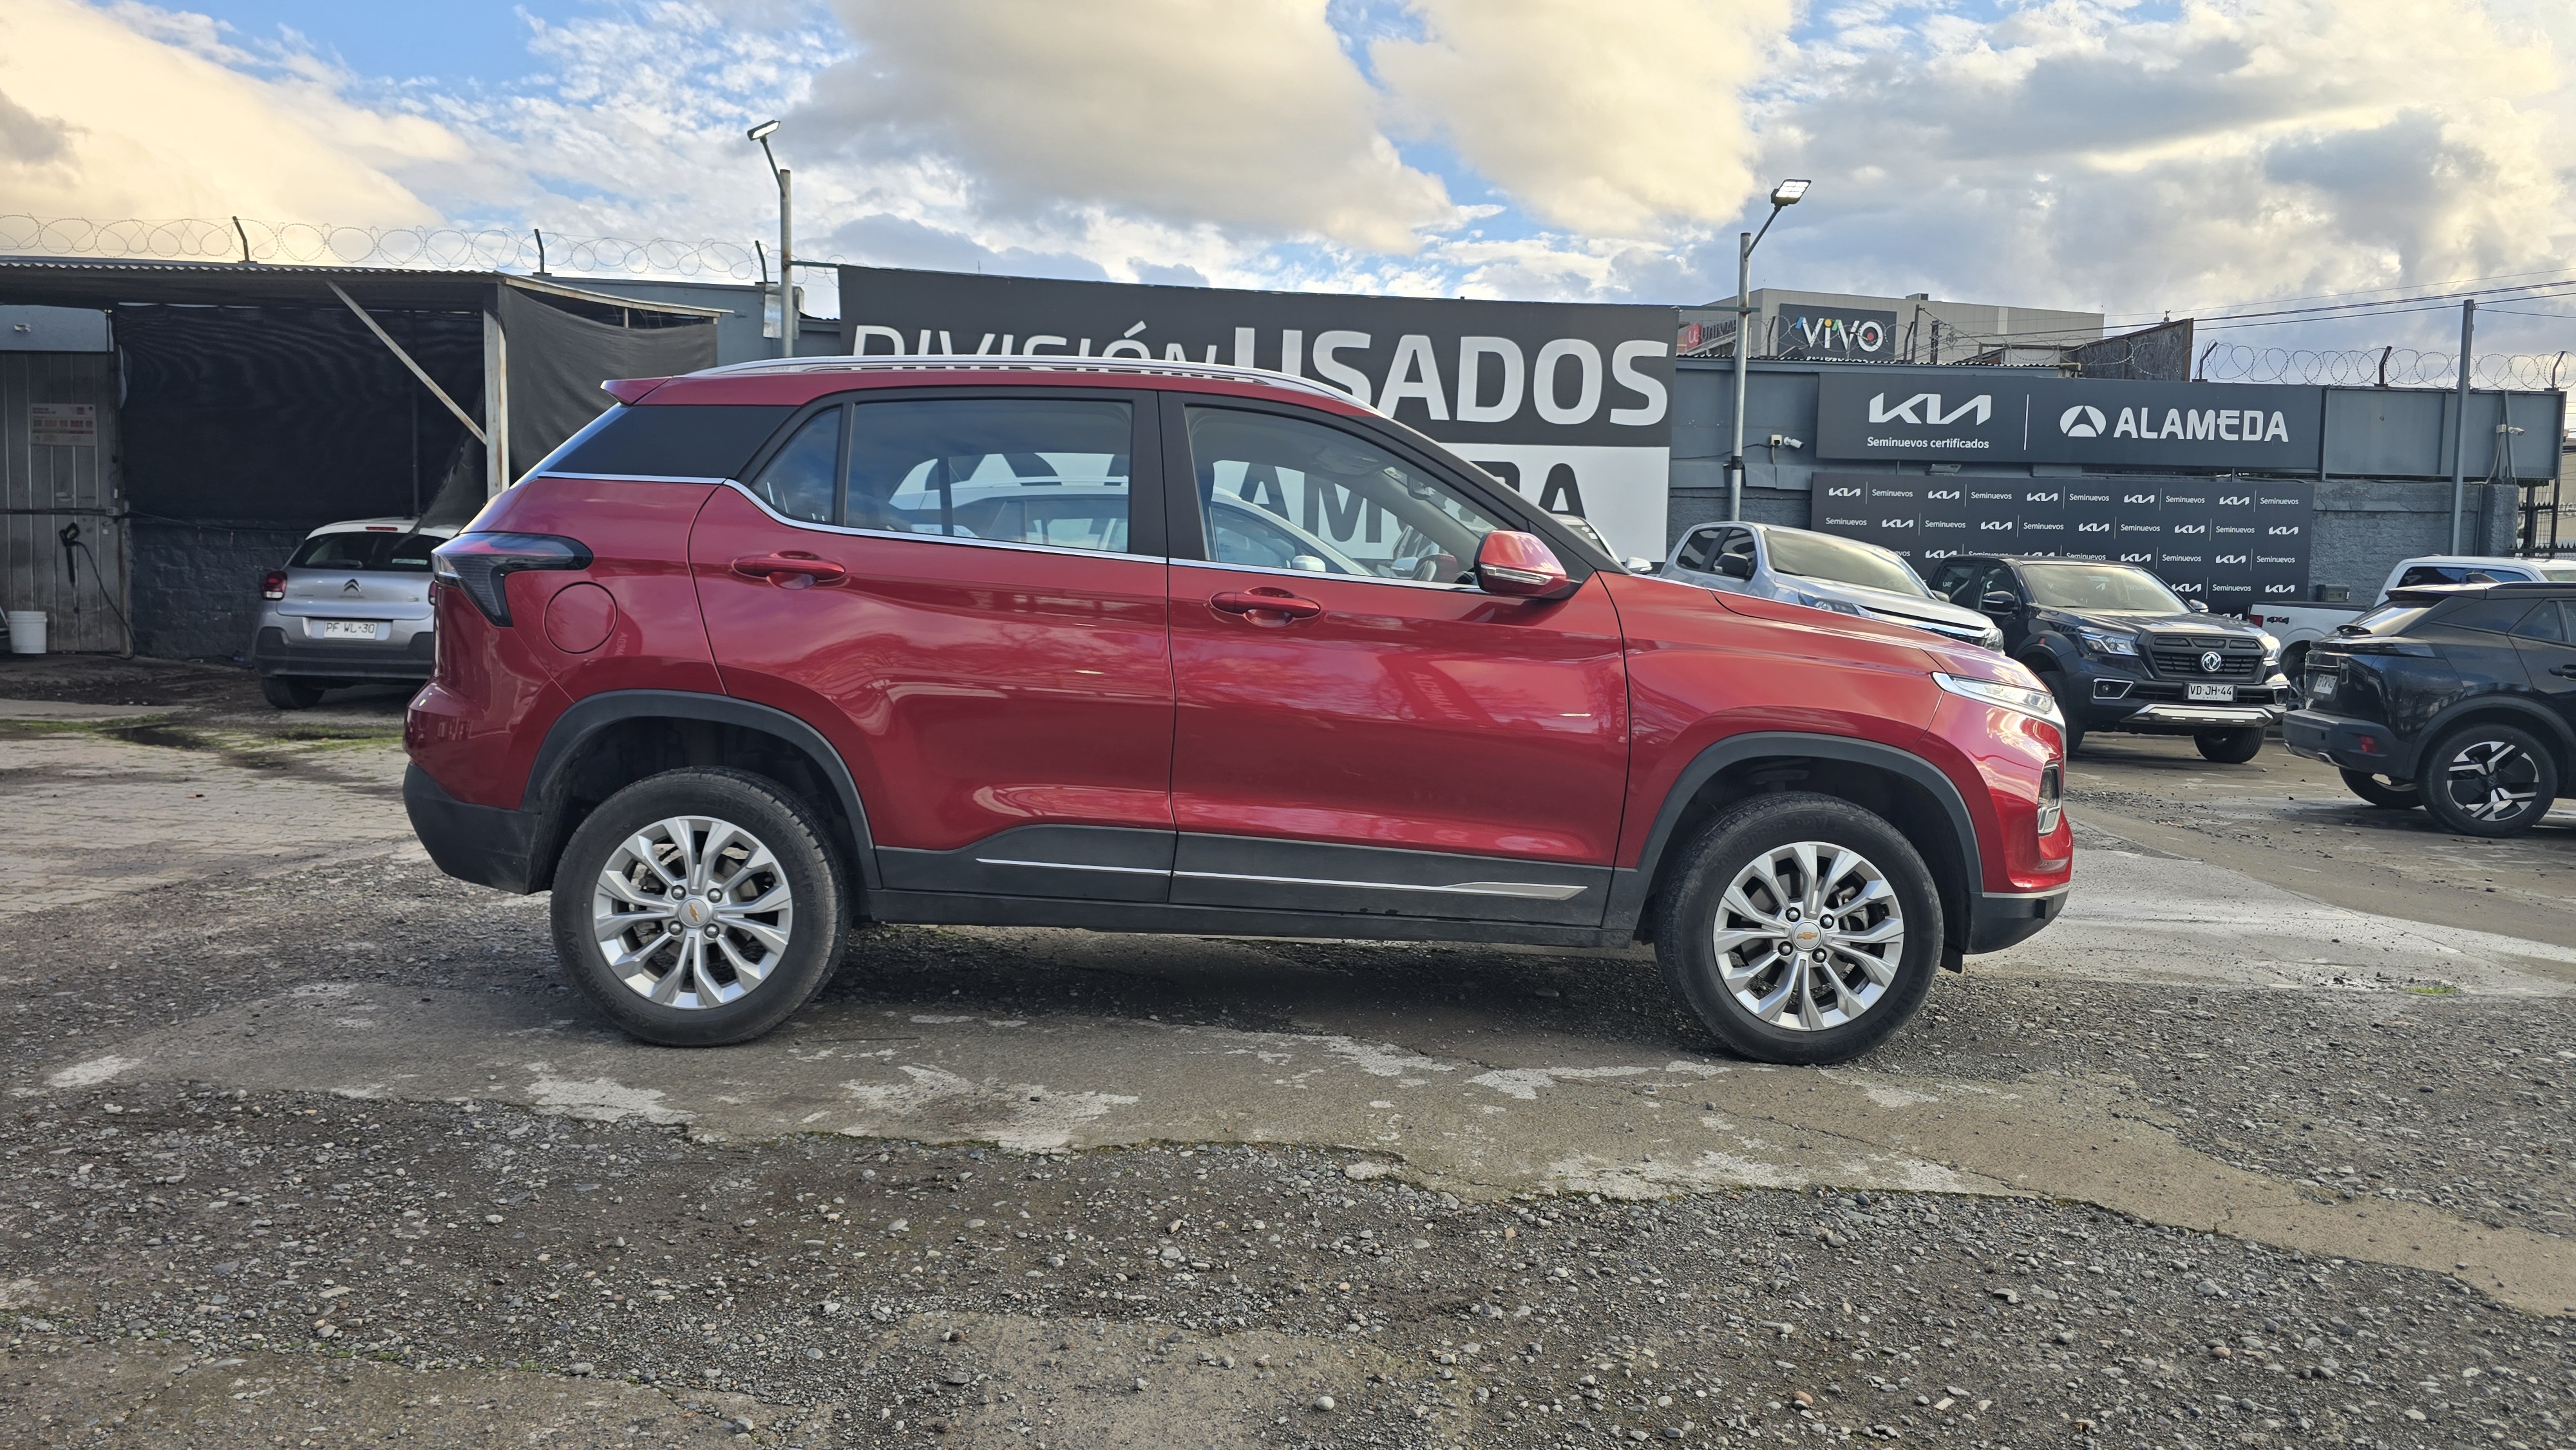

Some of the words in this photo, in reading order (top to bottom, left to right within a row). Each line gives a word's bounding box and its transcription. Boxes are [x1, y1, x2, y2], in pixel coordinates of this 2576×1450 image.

[1869, 393, 1991, 425] KIA
[2114, 408, 2288, 442] ALAMEDA
[1868, 437, 1927, 447] Seminuevos
[1930, 438, 1989, 448] certificados
[1829, 488, 1861, 496] KIA
[1928, 491, 1960, 499] KIA
[1981, 522, 2012, 530] KIA
[2121, 554, 2151, 562] KIA
